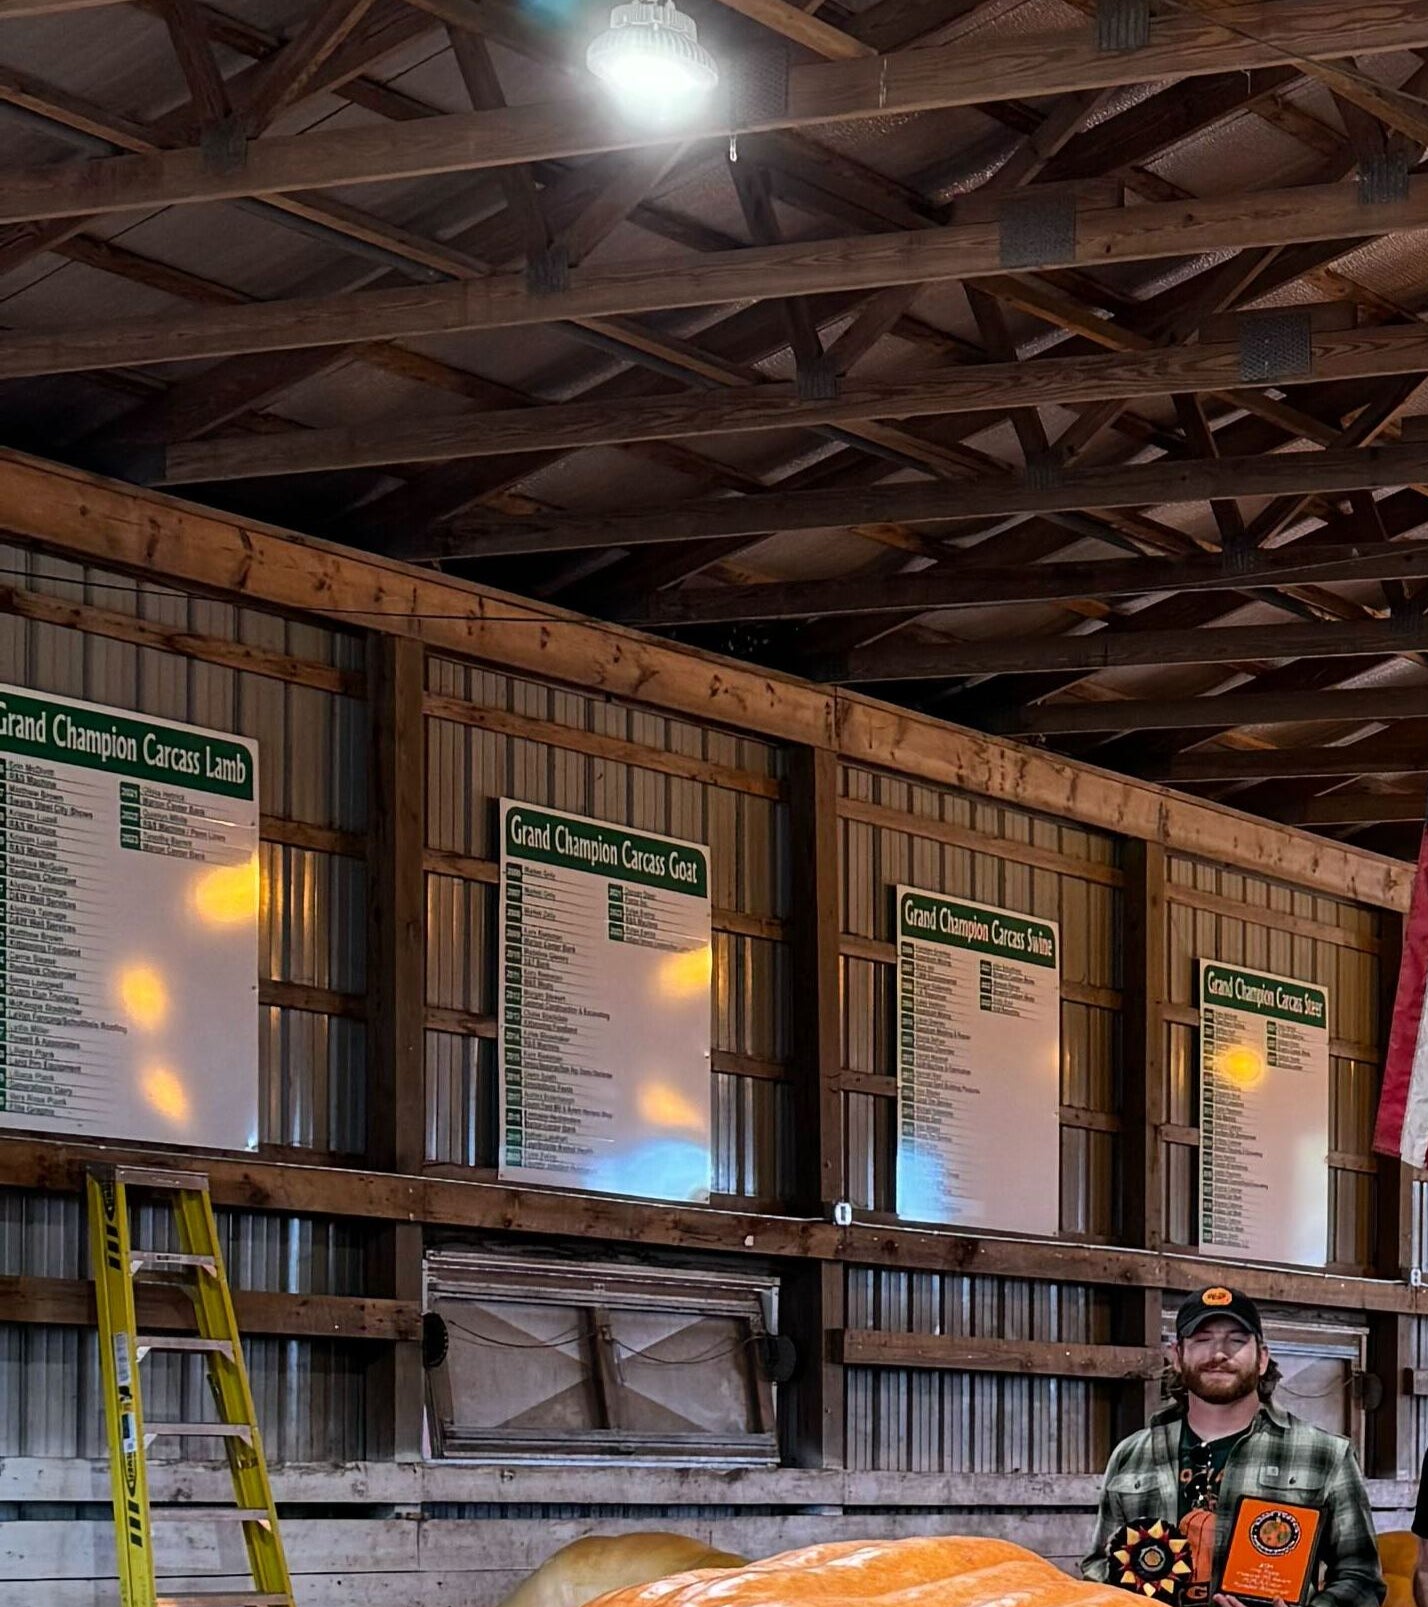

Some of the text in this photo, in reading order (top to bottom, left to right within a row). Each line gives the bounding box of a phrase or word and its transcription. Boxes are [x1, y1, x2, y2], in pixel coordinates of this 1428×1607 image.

[53, 714, 137, 762] Champion
[143, 733, 199, 774] Carcass
[206, 746, 246, 784] Lamb
[511, 815, 697, 883] Grand Champion Carcass Goat
[905, 900, 1052, 956] Grand Champion Carcass Swine
[1208, 971, 1322, 1017] Grand Champion Carcass Steer
